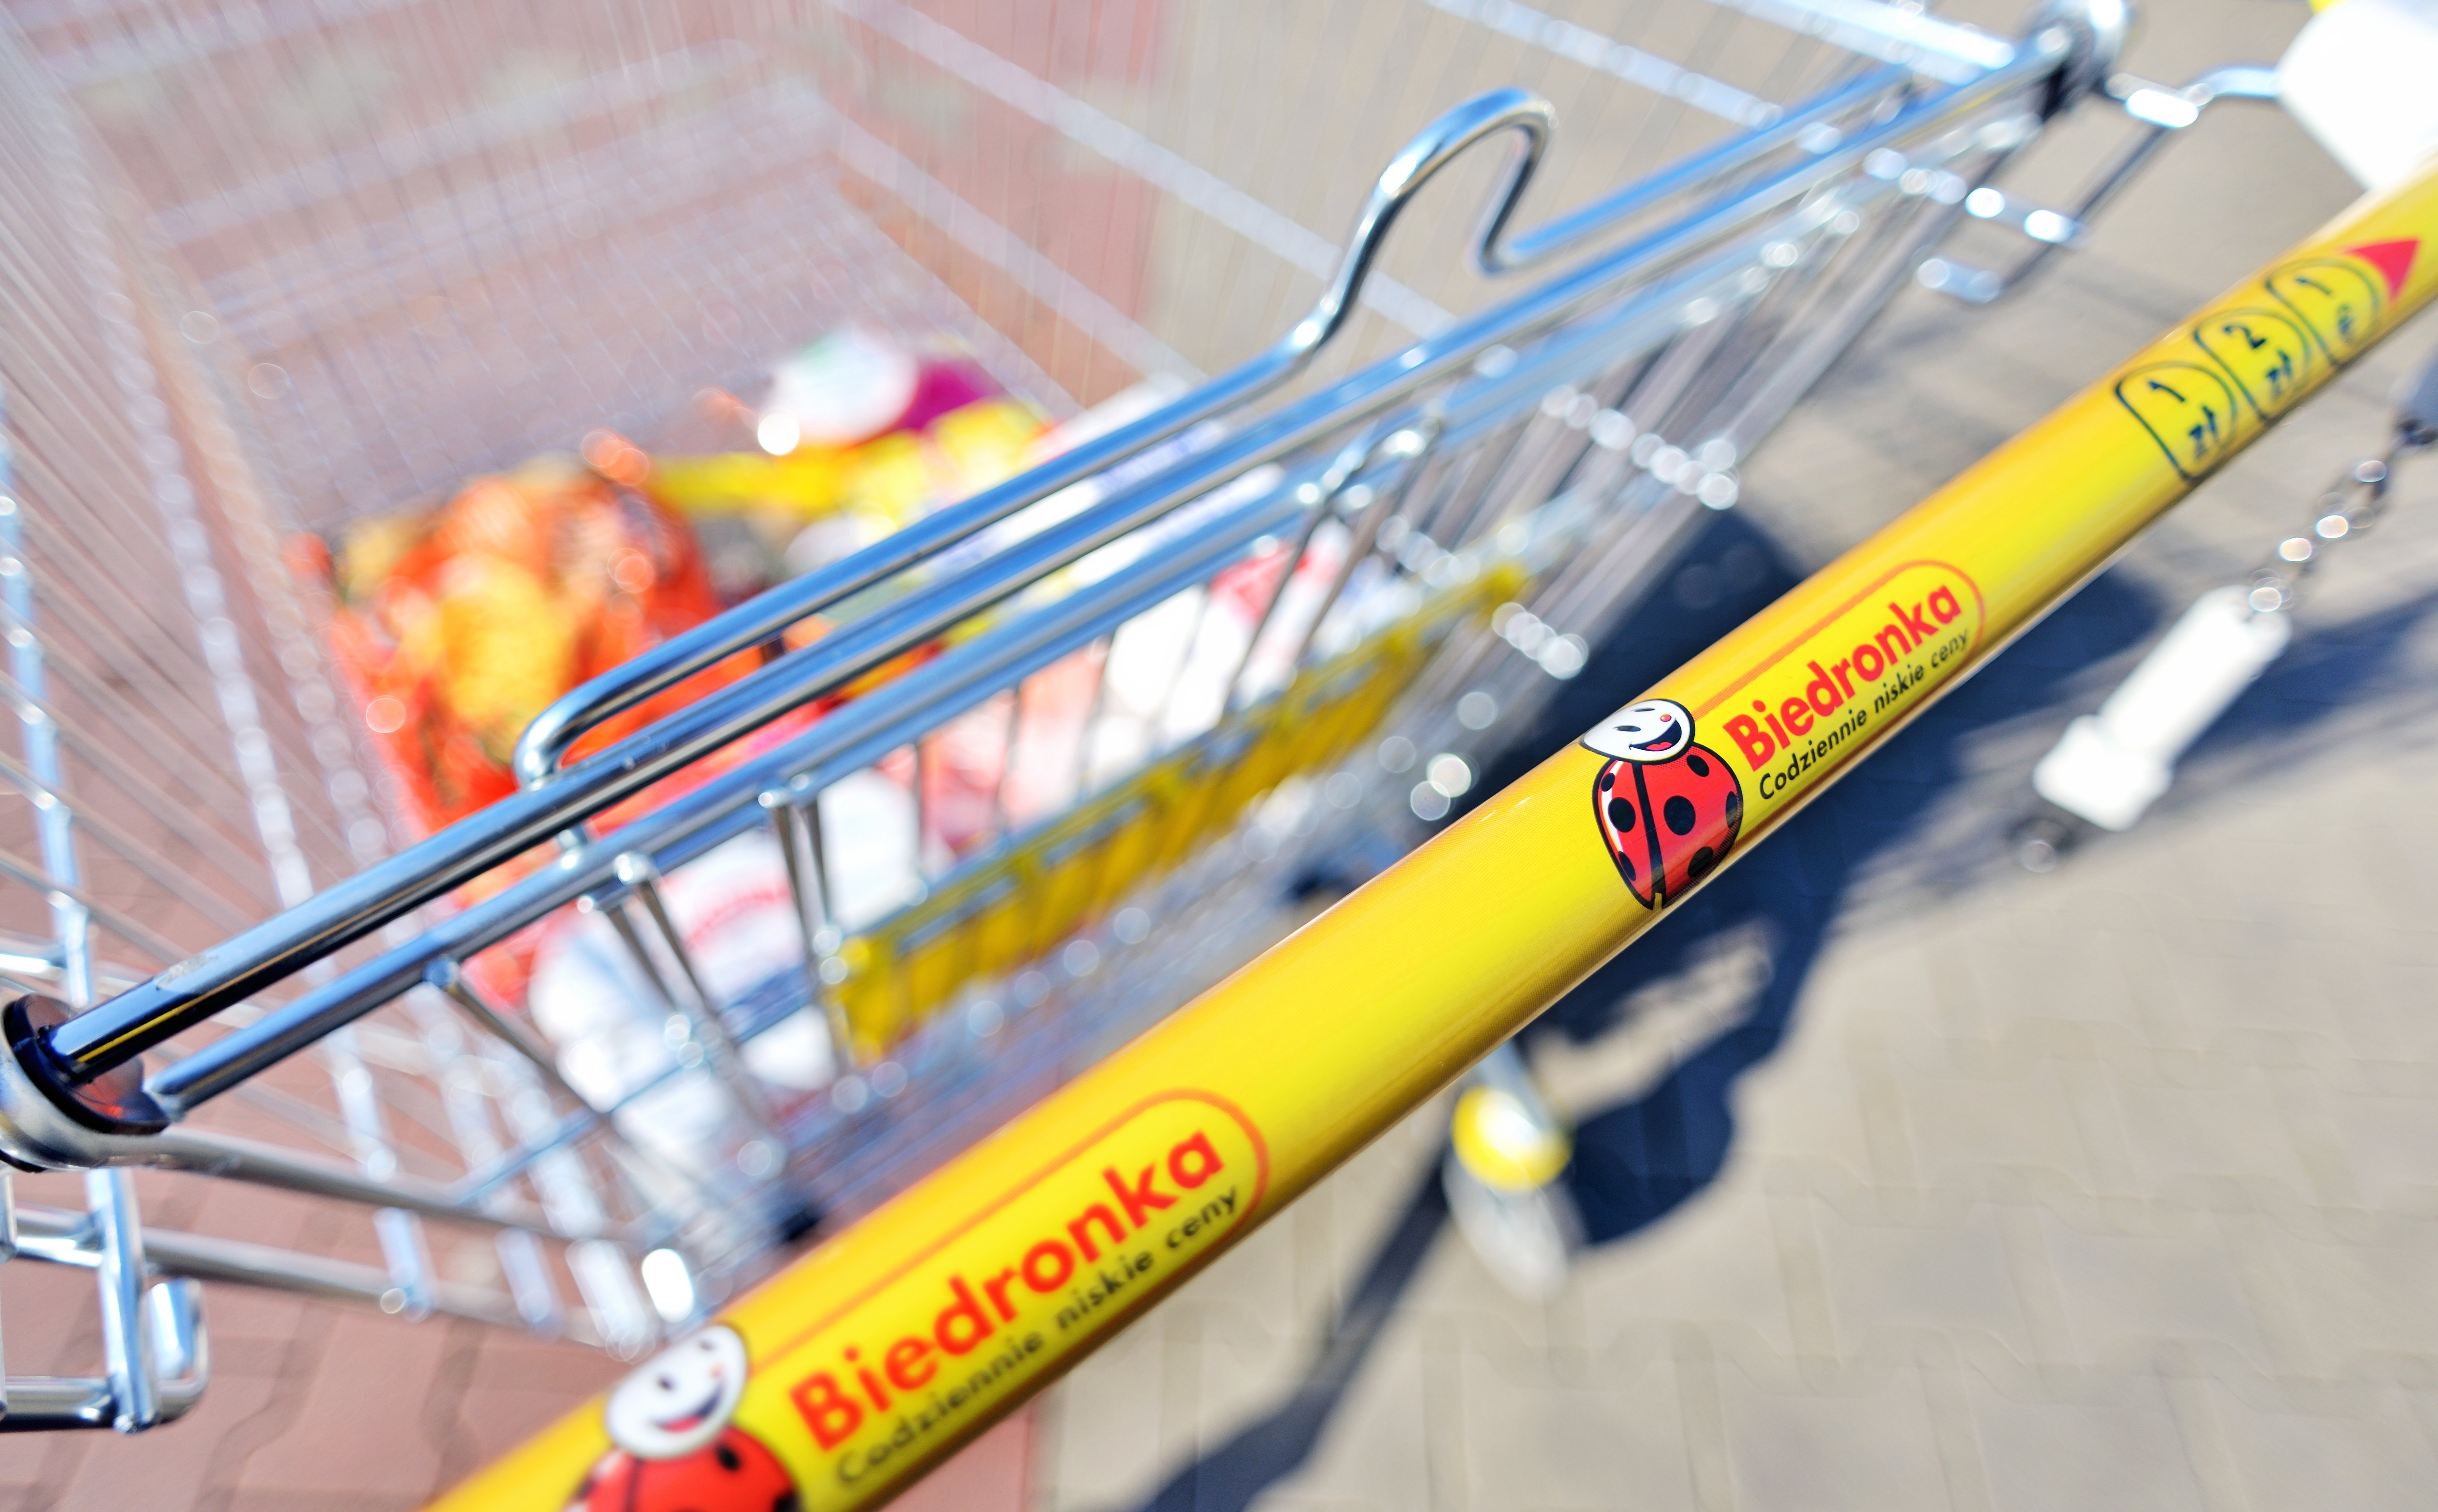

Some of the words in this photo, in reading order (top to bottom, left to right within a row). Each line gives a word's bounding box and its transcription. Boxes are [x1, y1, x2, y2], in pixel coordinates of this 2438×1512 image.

[2222, 324, 2267, 350] 2
[2294, 276, 2332, 296] 1
[2147, 378, 2186, 402] 1
[1722, 585, 1962, 771] Biedronka
[1759, 709, 1867, 800] Codziennie
[1874, 664, 1924, 714] niskie
[1931, 629, 1970, 668] ceny
[788, 1130, 1225, 1453] Biedronka
[837, 1327, 1045, 1484] Codziennie
[1056, 1251, 1154, 1331] niskie
[1166, 1186, 1238, 1249] ceny
